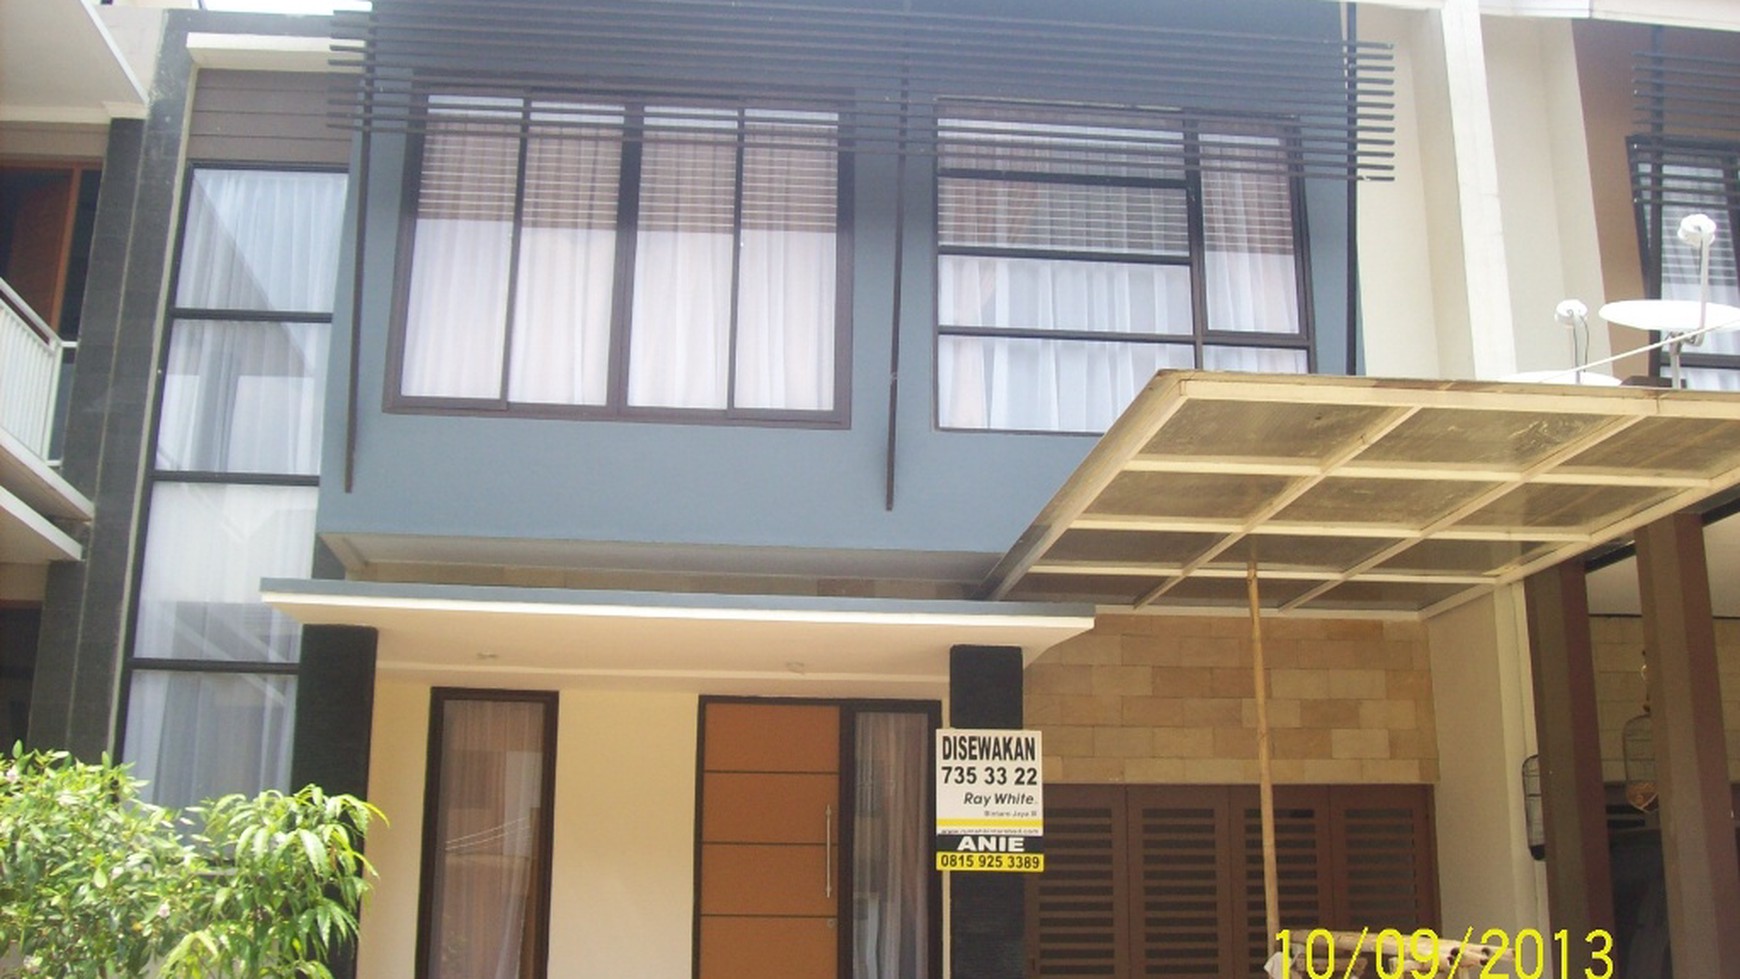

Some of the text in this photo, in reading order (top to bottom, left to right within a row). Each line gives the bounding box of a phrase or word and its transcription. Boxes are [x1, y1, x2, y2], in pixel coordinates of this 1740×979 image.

[942, 735, 1036, 761] DISEWAKAN
[941, 766, 1038, 786] 735 33 22
[963, 792, 1034, 807] Ray White
[957, 835, 1025, 853] ANIE
[940, 854, 1040, 869] 0815 925 3389
